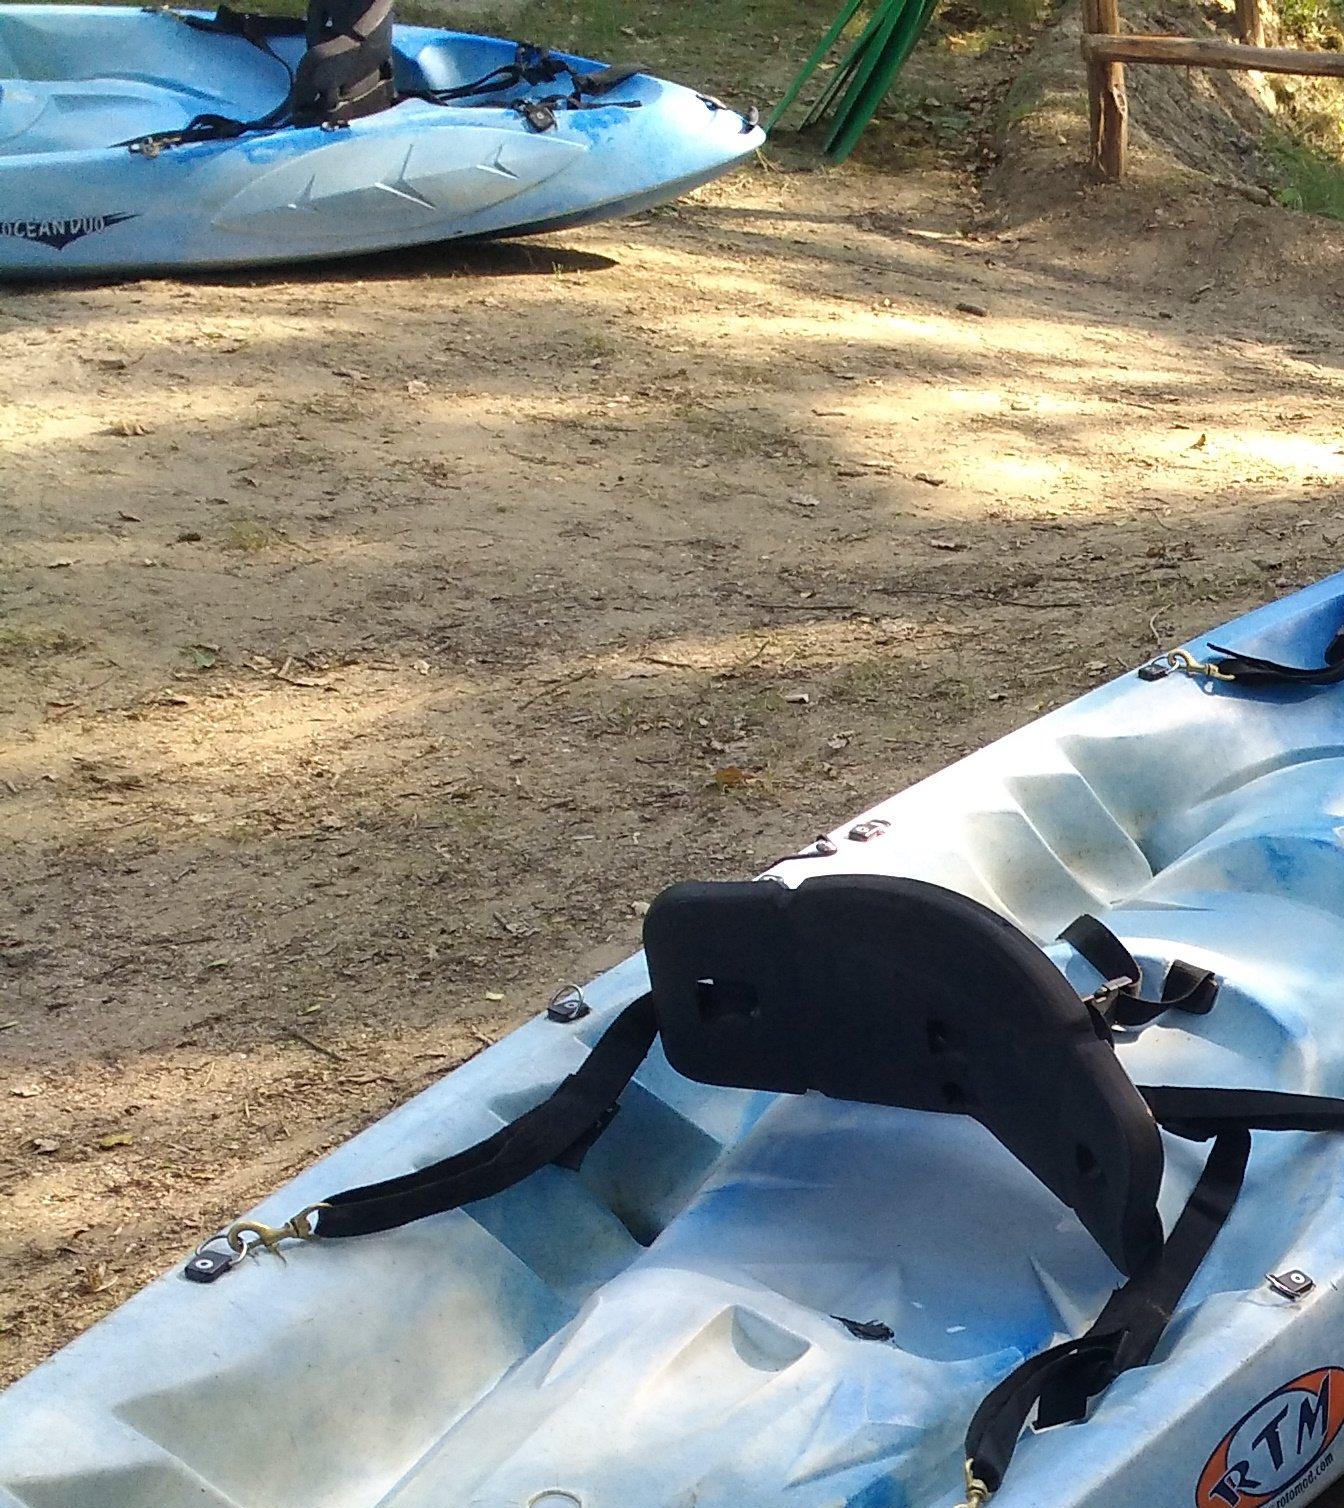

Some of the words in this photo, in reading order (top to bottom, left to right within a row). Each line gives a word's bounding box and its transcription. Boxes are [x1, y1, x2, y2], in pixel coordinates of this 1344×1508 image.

[1, 219, 65, 237] OCEAN
[69, 217, 104, 235] DUO
[1208, 1372, 1331, 1508] RTM
